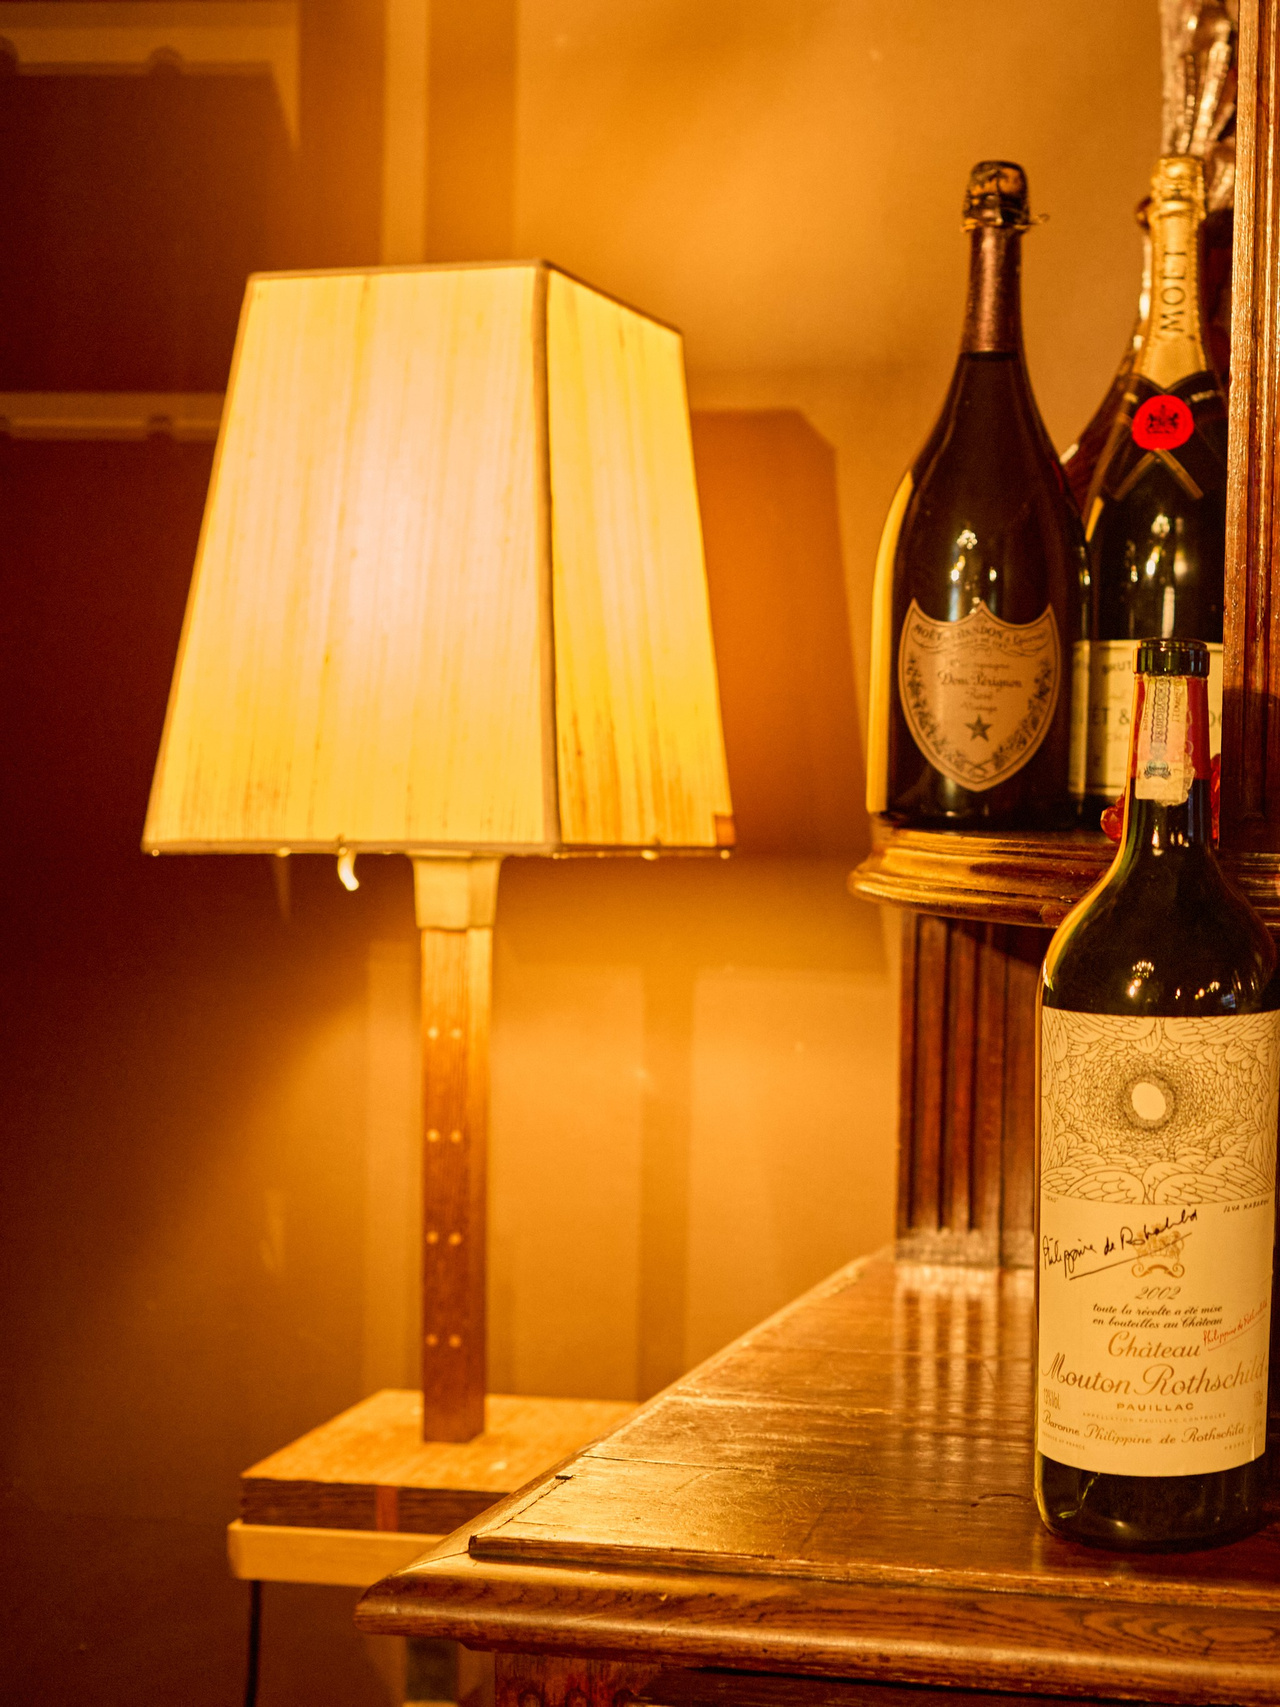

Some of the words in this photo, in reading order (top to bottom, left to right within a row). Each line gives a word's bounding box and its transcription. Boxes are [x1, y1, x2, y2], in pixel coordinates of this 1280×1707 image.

[1134, 1286, 1182, 1300] 2002
[1092, 1302, 1118, 1314] toute
[1121, 1303, 1132, 1315] la
[1108, 1315, 1160, 1329] bouteilles
[1163, 1320, 1179, 1329] au
[1107, 1330, 1201, 1359] Château
[1041, 1352, 1132, 1395] Mouton
[1132, 1353, 1267, 1397] Rothschild
[1116, 1402, 1195, 1413] PAUILLAC
[1041, 1410, 1081, 1437] Baronne
[1084, 1422, 1152, 1447] Philippine
[1158, 1433, 1177, 1445] de
[1180, 1422, 1246, 1445] Rothschild
